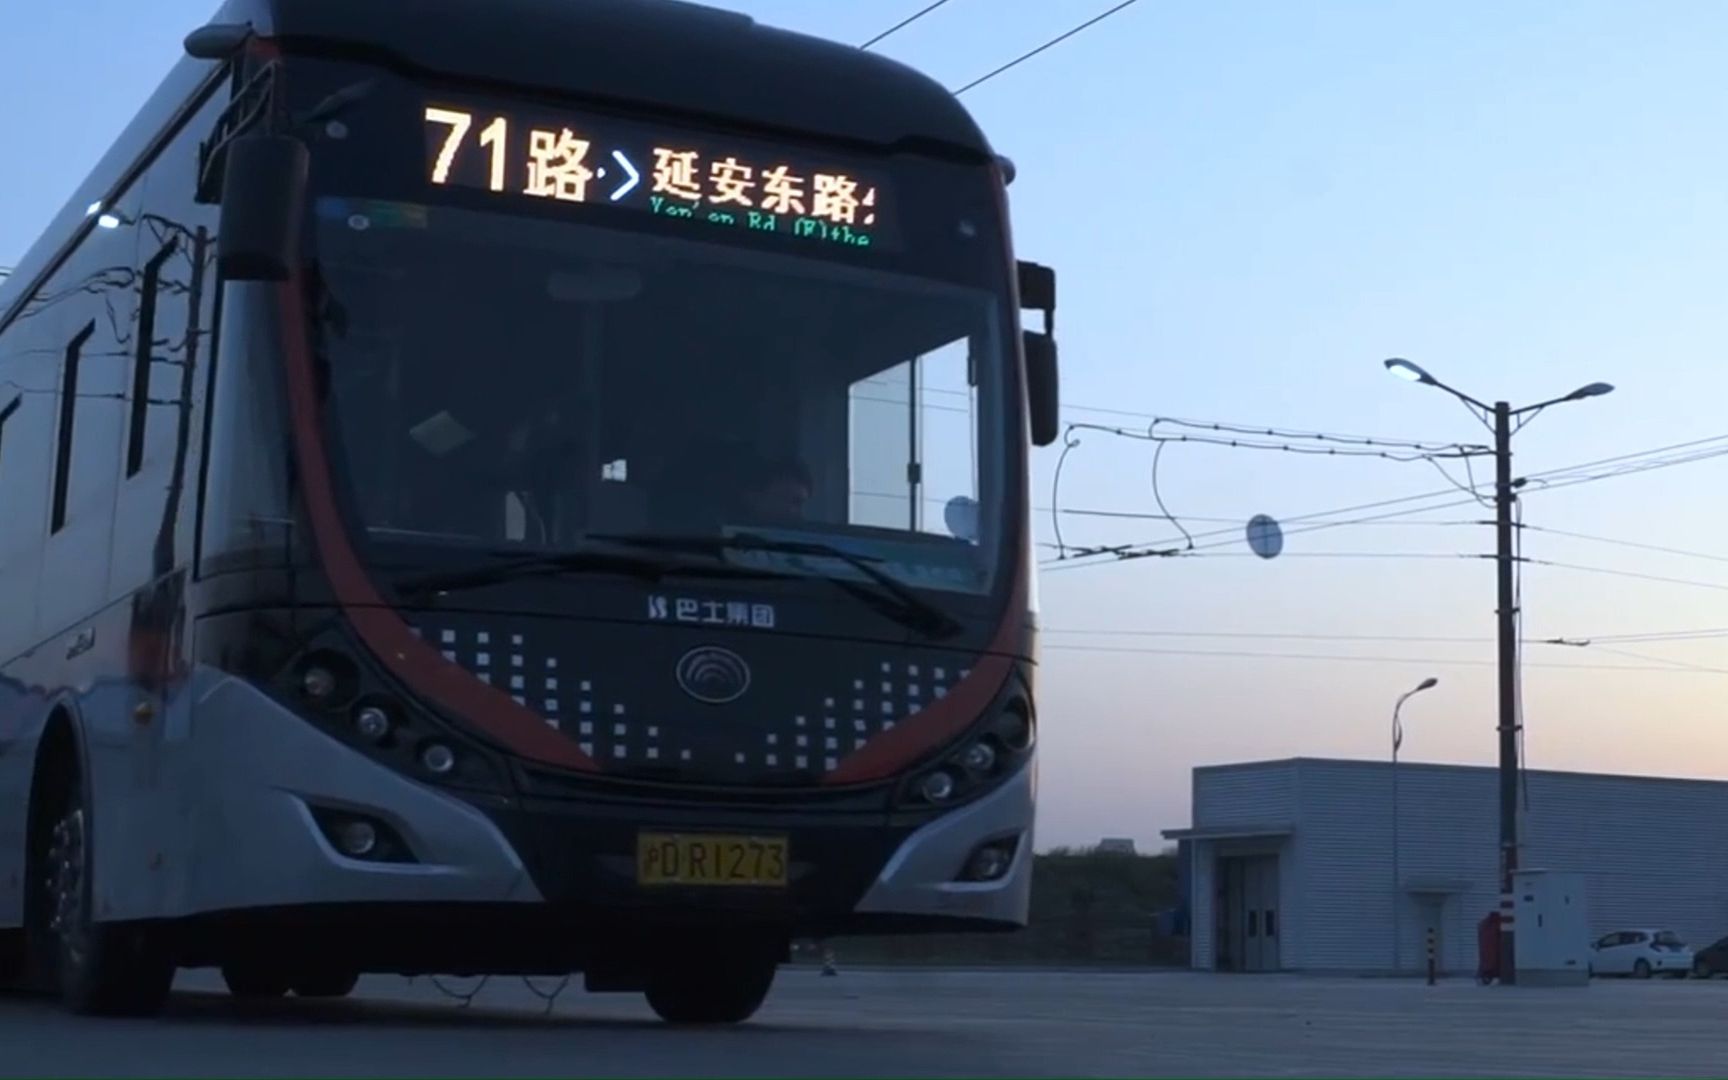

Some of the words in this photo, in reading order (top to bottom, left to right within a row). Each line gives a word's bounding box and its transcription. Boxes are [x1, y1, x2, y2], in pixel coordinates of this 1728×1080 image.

[424, 107, 593, 203] 71路
[747, 210, 776, 232] Rd
[676, 598, 775, 628] 巴士集团
